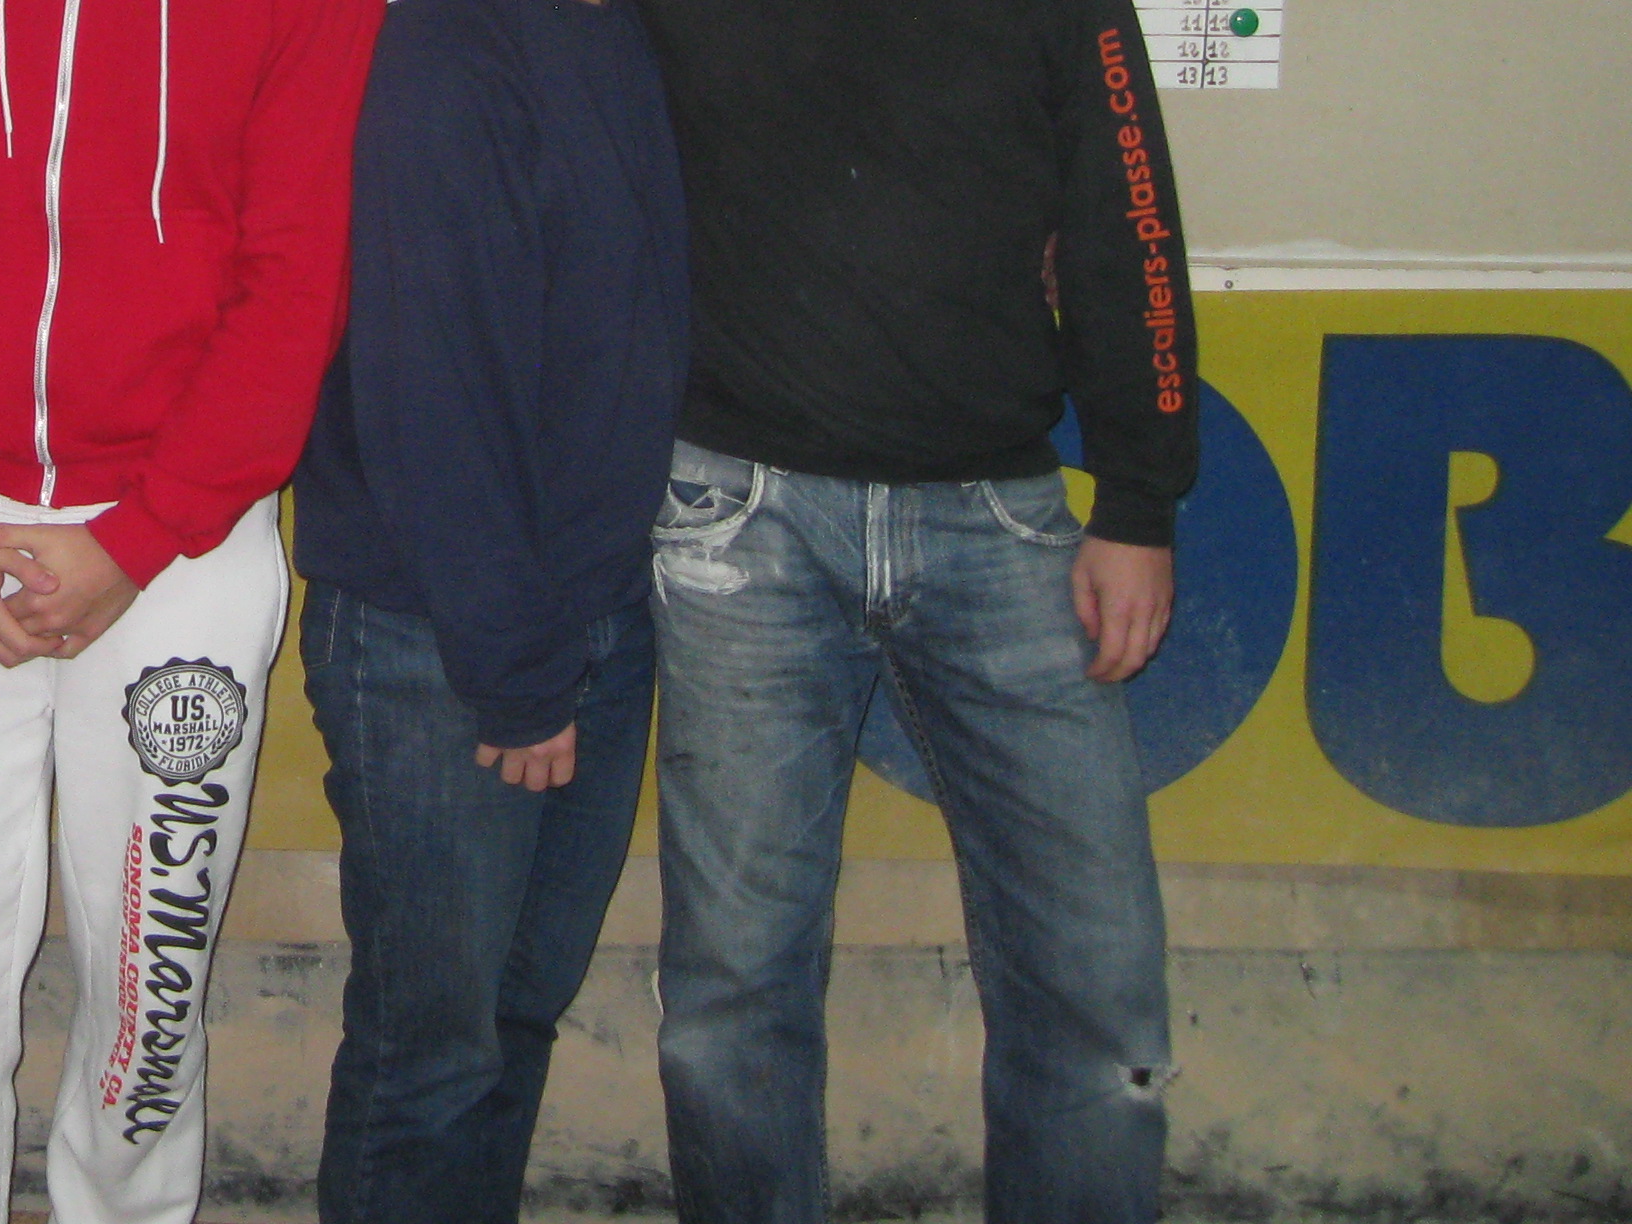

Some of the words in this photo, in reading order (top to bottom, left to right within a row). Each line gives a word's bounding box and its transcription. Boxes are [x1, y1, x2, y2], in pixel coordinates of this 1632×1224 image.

[1179, 13, 1203, 31] 11
[1177, 41, 1200, 58] 12
[1207, 40, 1230, 58] 12
[1176, 66, 1198, 85] 13
[1205, 65, 1229, 86] 13
[1097, 27, 1185, 414] escaliers-plasse.com
[136, 674, 182, 717] COLLEGE
[188, 674, 237, 716] ATHLETIC
[153, 720, 219, 735] MARSHALL
[169, 734, 204, 752] 1972
[158, 753, 211, 772] FLORIDA
[129, 822, 143, 954] SONOMA
[118, 962, 139, 1074] COUNTY
